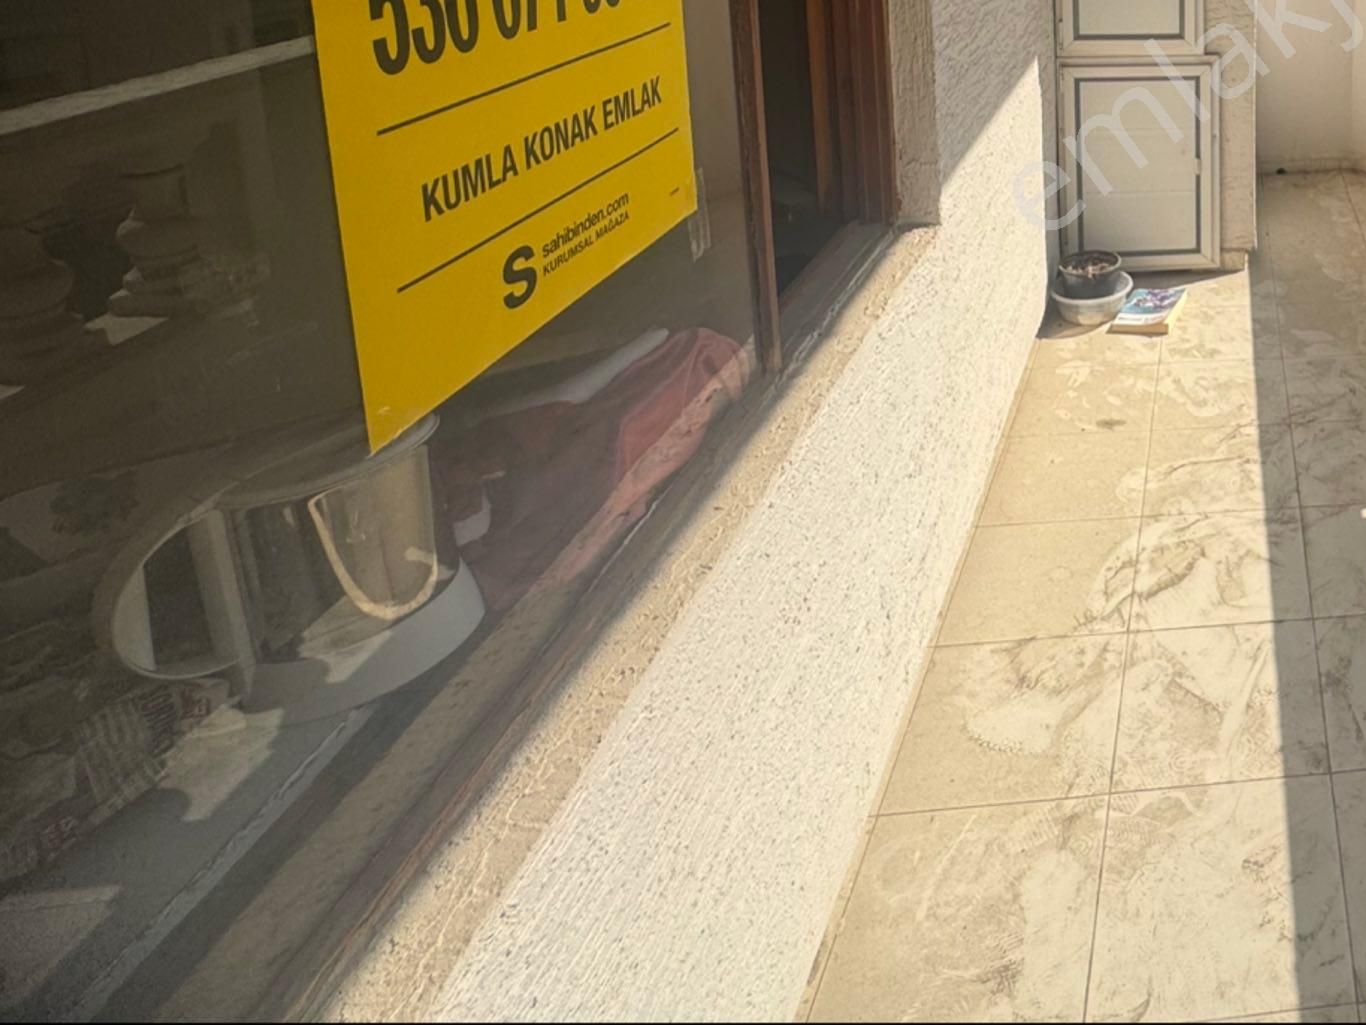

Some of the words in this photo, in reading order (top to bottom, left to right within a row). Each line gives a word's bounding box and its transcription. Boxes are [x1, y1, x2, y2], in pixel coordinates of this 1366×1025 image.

[421, 145, 518, 222] KUMLA
[524, 106, 599, 169] KONAK
[602, 76, 662, 131] EMLAK
[541, 192, 629, 258] sahibinden.com
[543, 238, 594, 276] KURUMSAL
[503, 245, 537, 310] S
